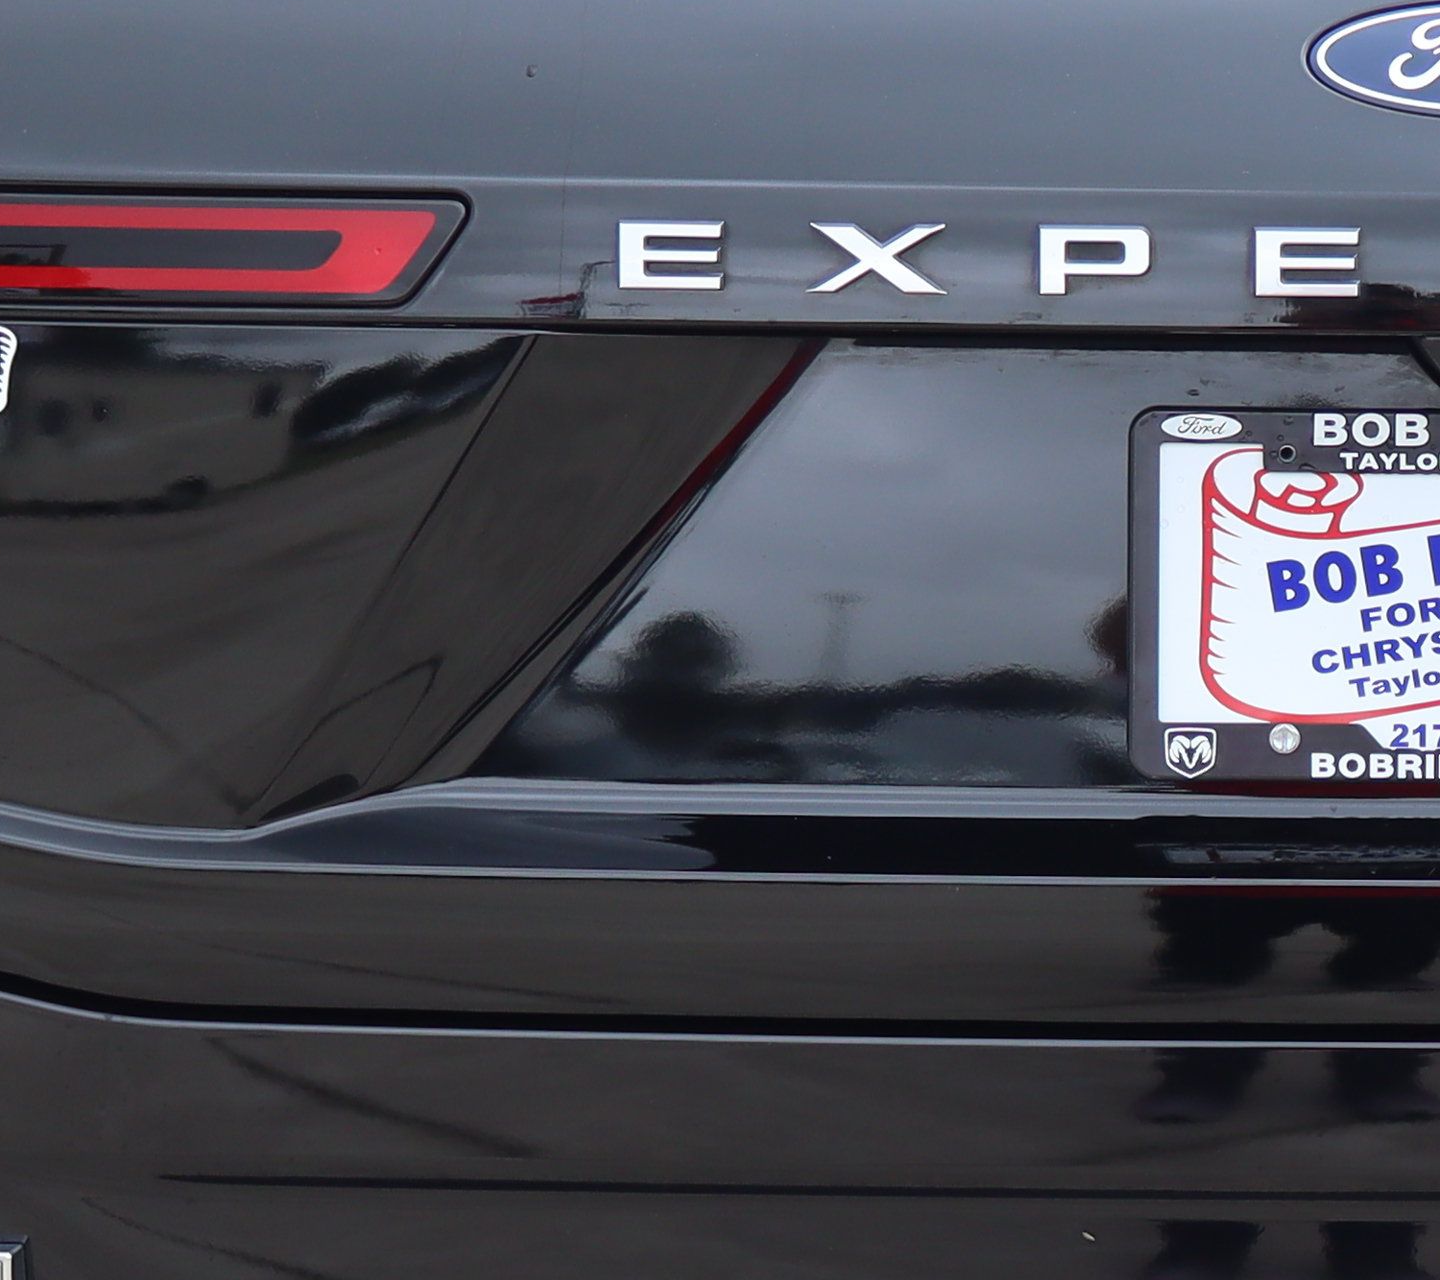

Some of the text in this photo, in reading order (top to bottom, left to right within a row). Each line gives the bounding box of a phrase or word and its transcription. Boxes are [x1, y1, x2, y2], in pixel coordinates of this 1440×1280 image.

[1176, 416, 1227, 436] Ford
[1313, 413, 1429, 448] BOB
[1267, 543, 1404, 612] BOB
